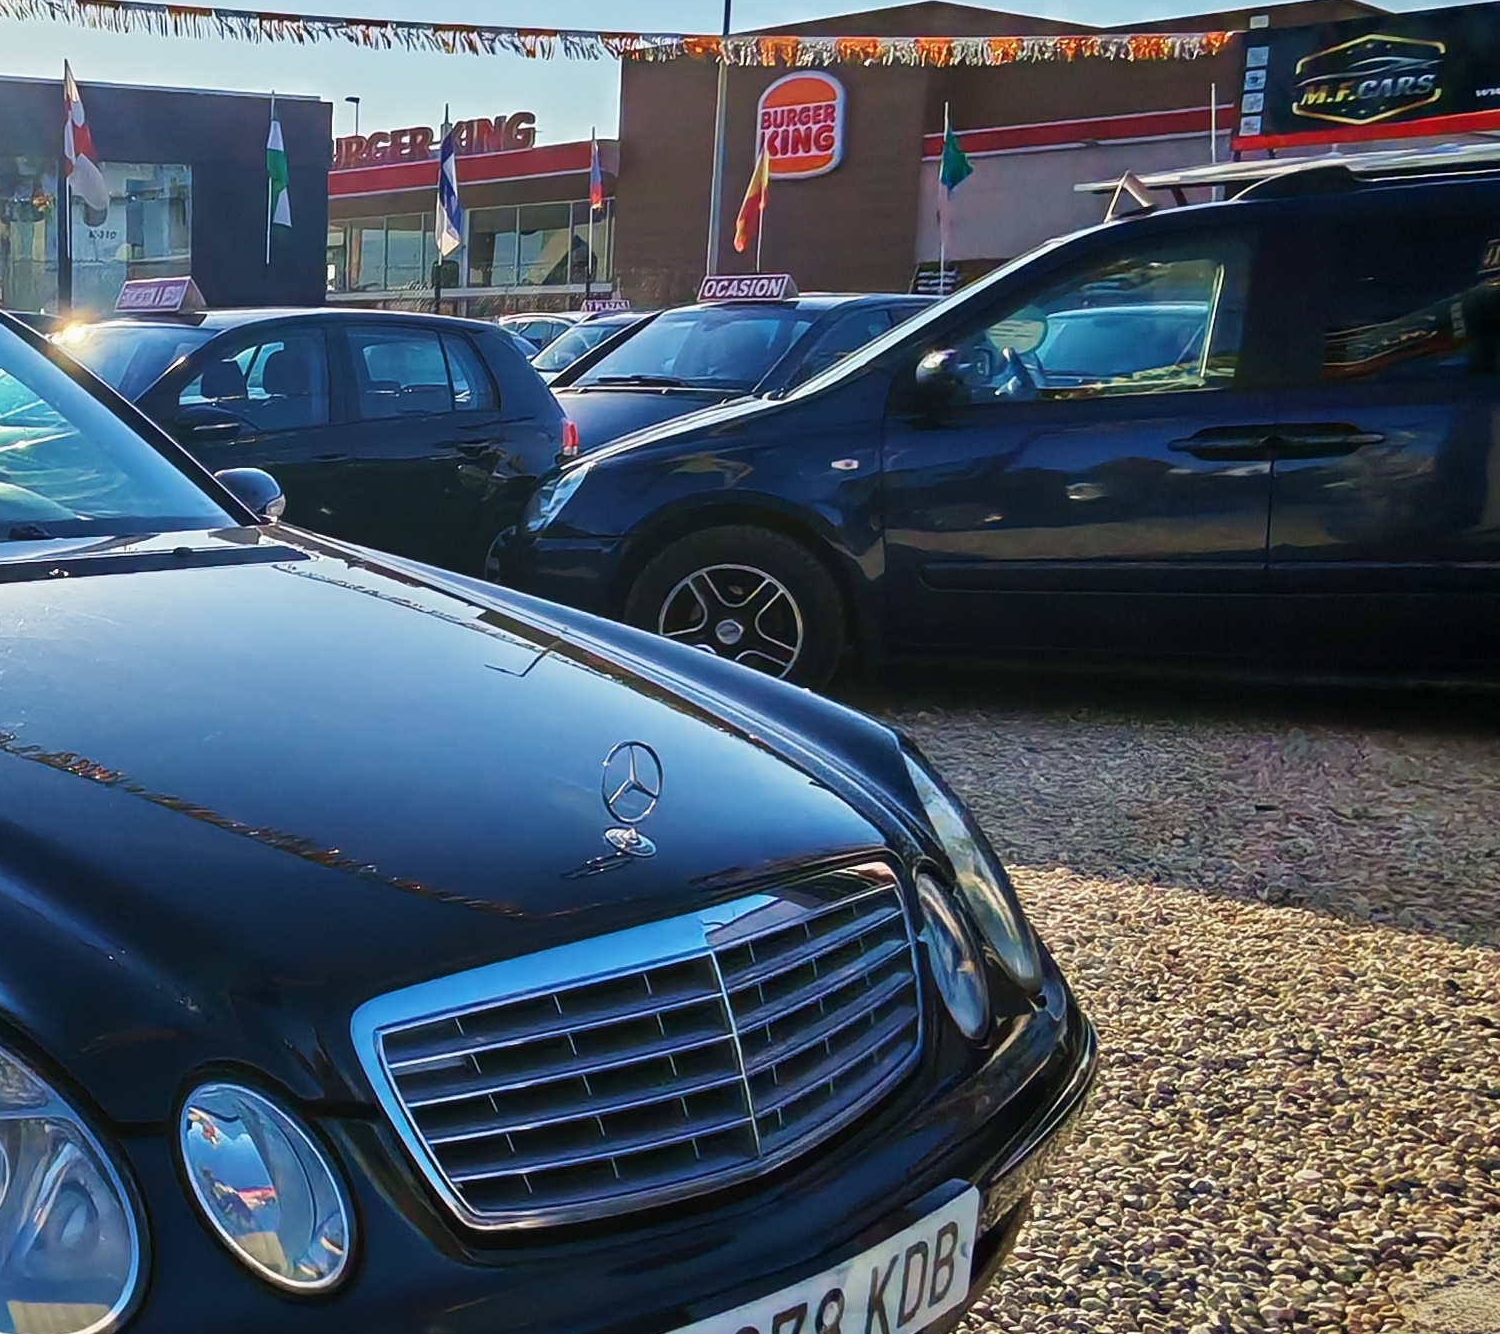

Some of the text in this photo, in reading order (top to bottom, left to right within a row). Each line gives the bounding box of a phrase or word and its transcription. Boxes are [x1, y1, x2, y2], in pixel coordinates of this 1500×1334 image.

[1300, 73, 1437, 106] M.F.CARS
[761, 103, 836, 130] BURGER
[759, 124, 835, 157] KING
[703, 278, 784, 297] OCASION
